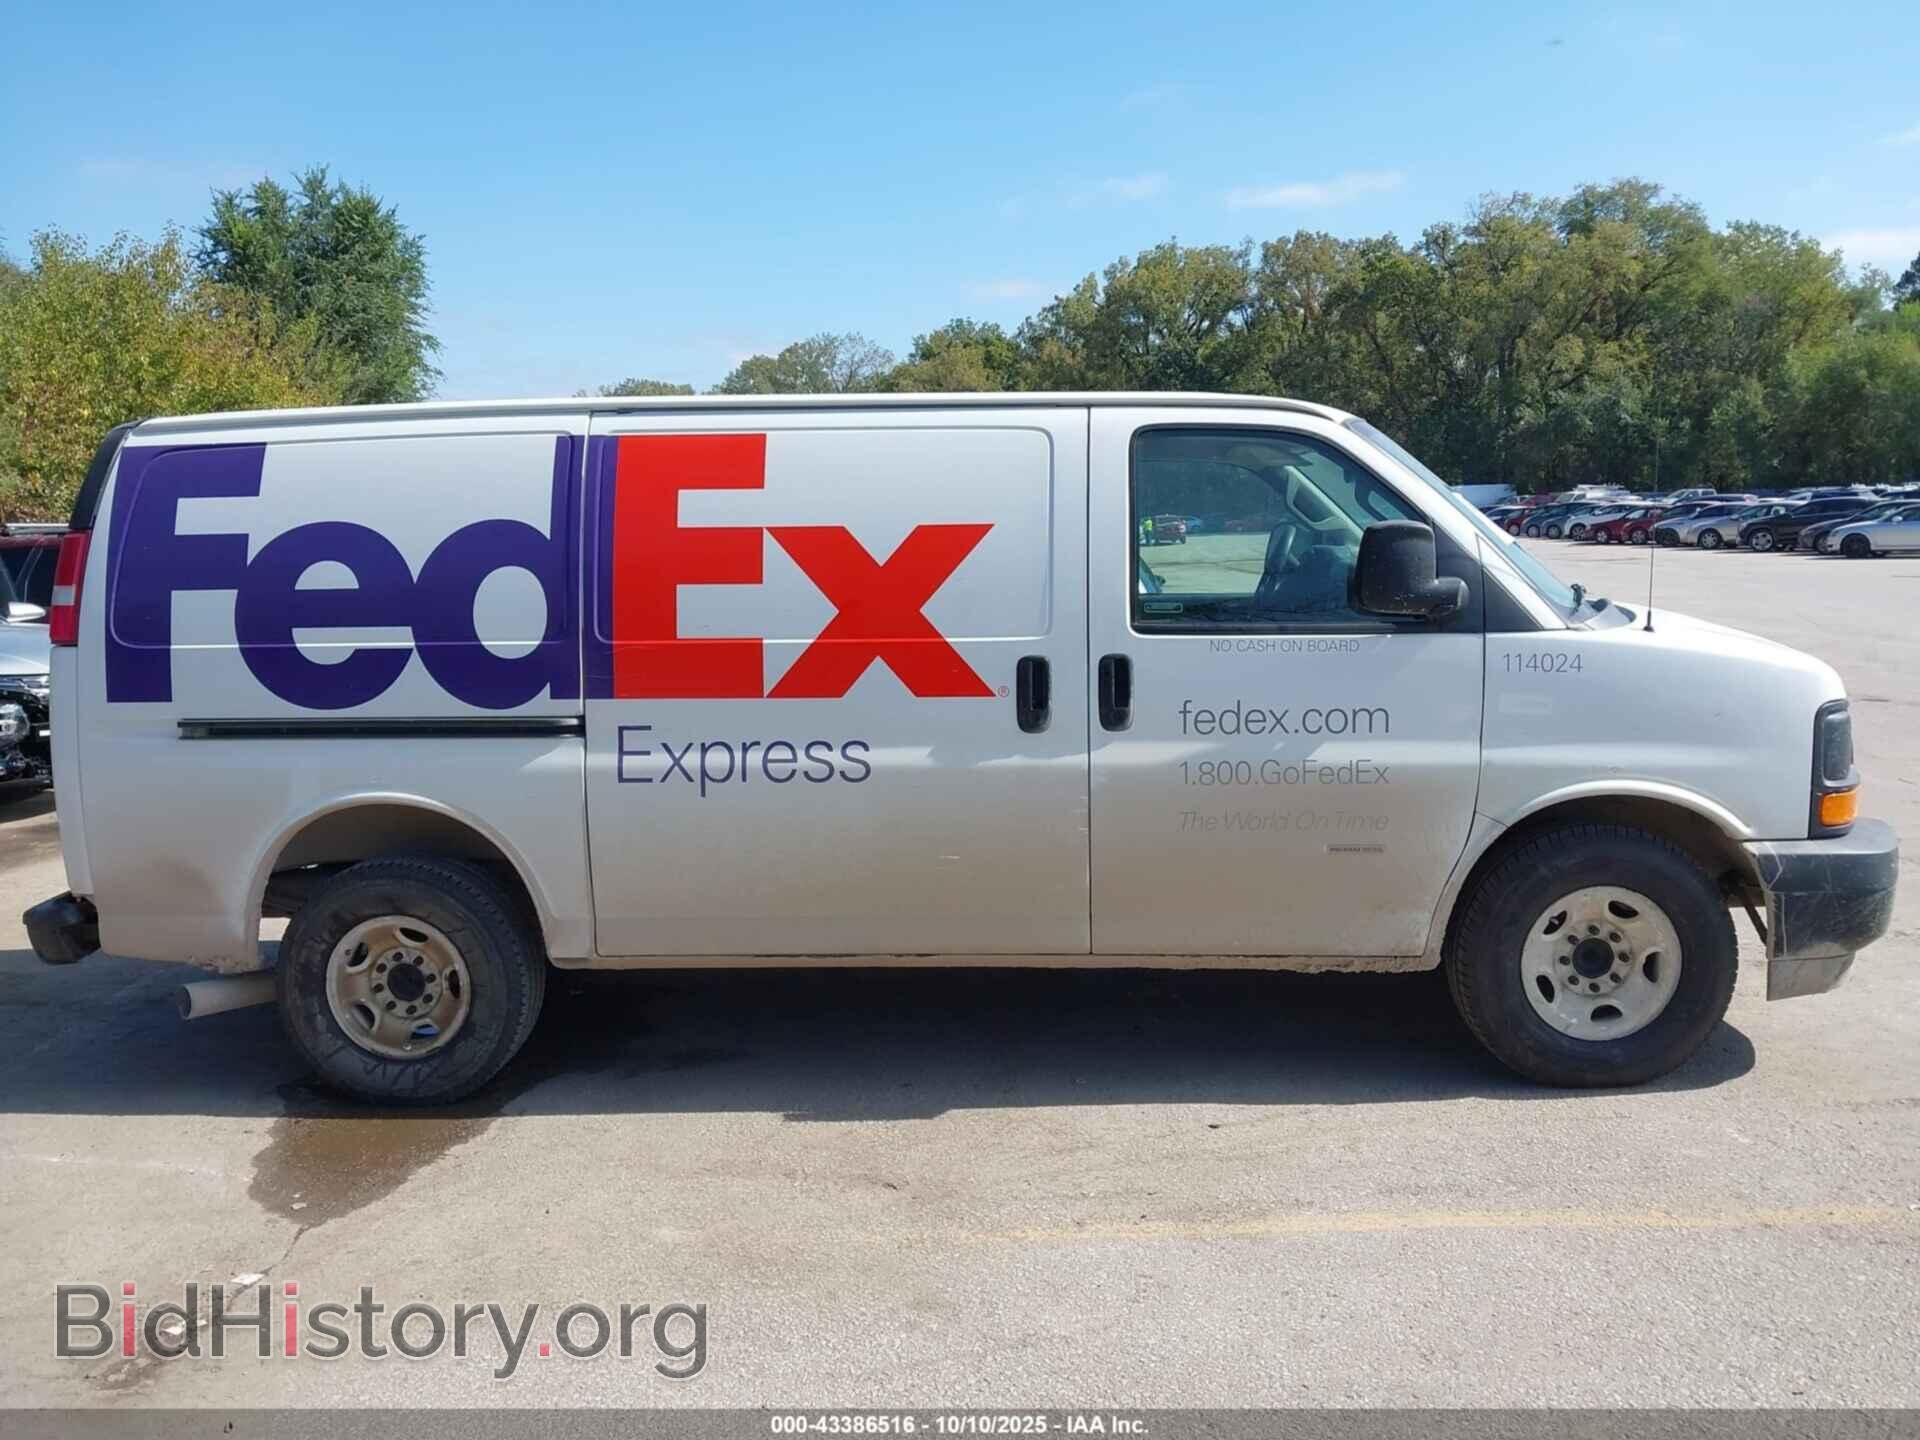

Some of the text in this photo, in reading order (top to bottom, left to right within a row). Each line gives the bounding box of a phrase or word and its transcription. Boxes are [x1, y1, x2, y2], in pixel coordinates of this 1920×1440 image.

[106, 433, 996, 711] FedEx
[1210, 639, 1360, 653] NO CASH ON BOARD
[1503, 653, 1583, 673] 114024
[1178, 700, 1390, 735] fedex.com
[617, 725, 872, 797] Express
[1179, 760, 1390, 785] 1.800.GoFedEx
[1180, 809, 1389, 832] The World On Time
